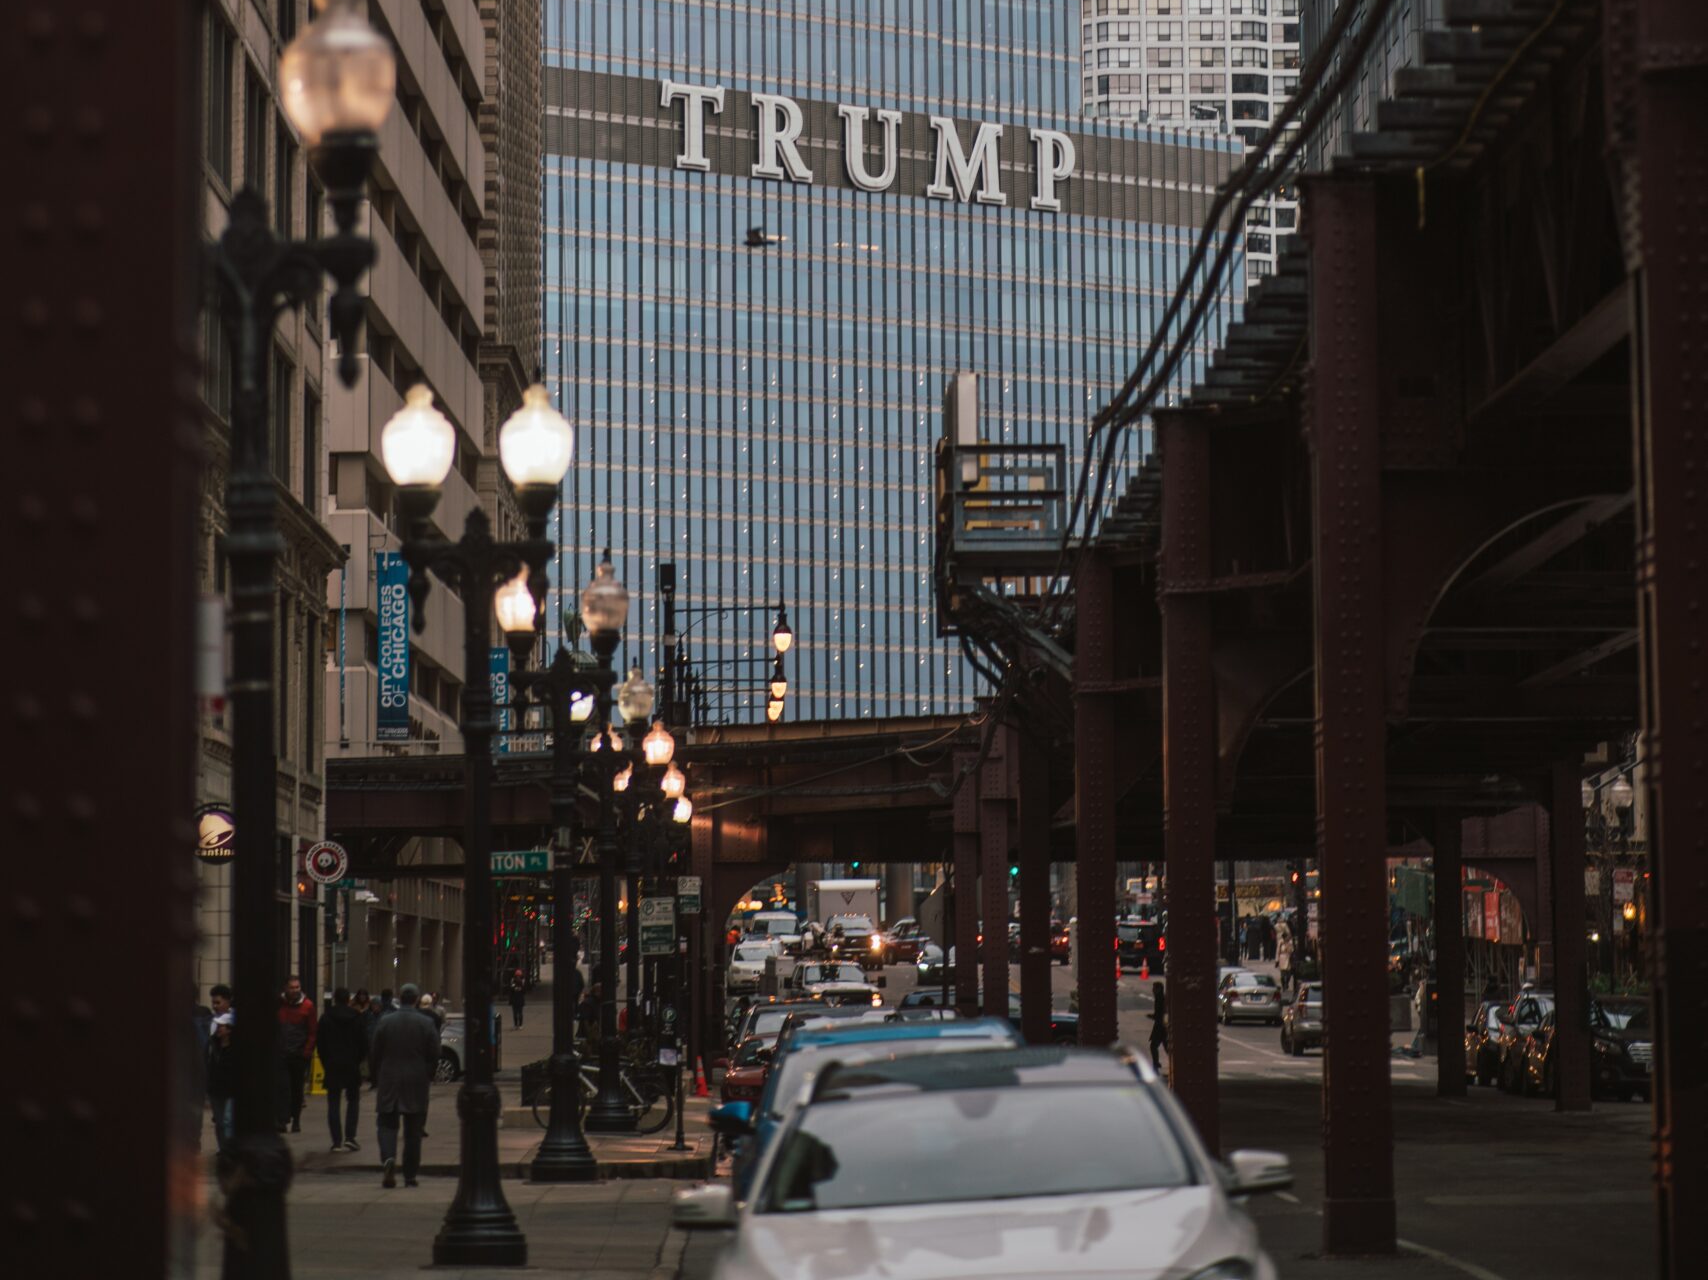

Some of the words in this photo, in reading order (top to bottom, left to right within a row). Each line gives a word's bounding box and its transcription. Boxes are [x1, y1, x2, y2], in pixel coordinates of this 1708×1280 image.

[660, 79, 1076, 212] TRUMP
[381, 584, 392, 669] COLLEGES
[392, 583, 406, 679] CHICAGO
[381, 672, 392, 708] CITY
[392, 684, 406, 707] OF
